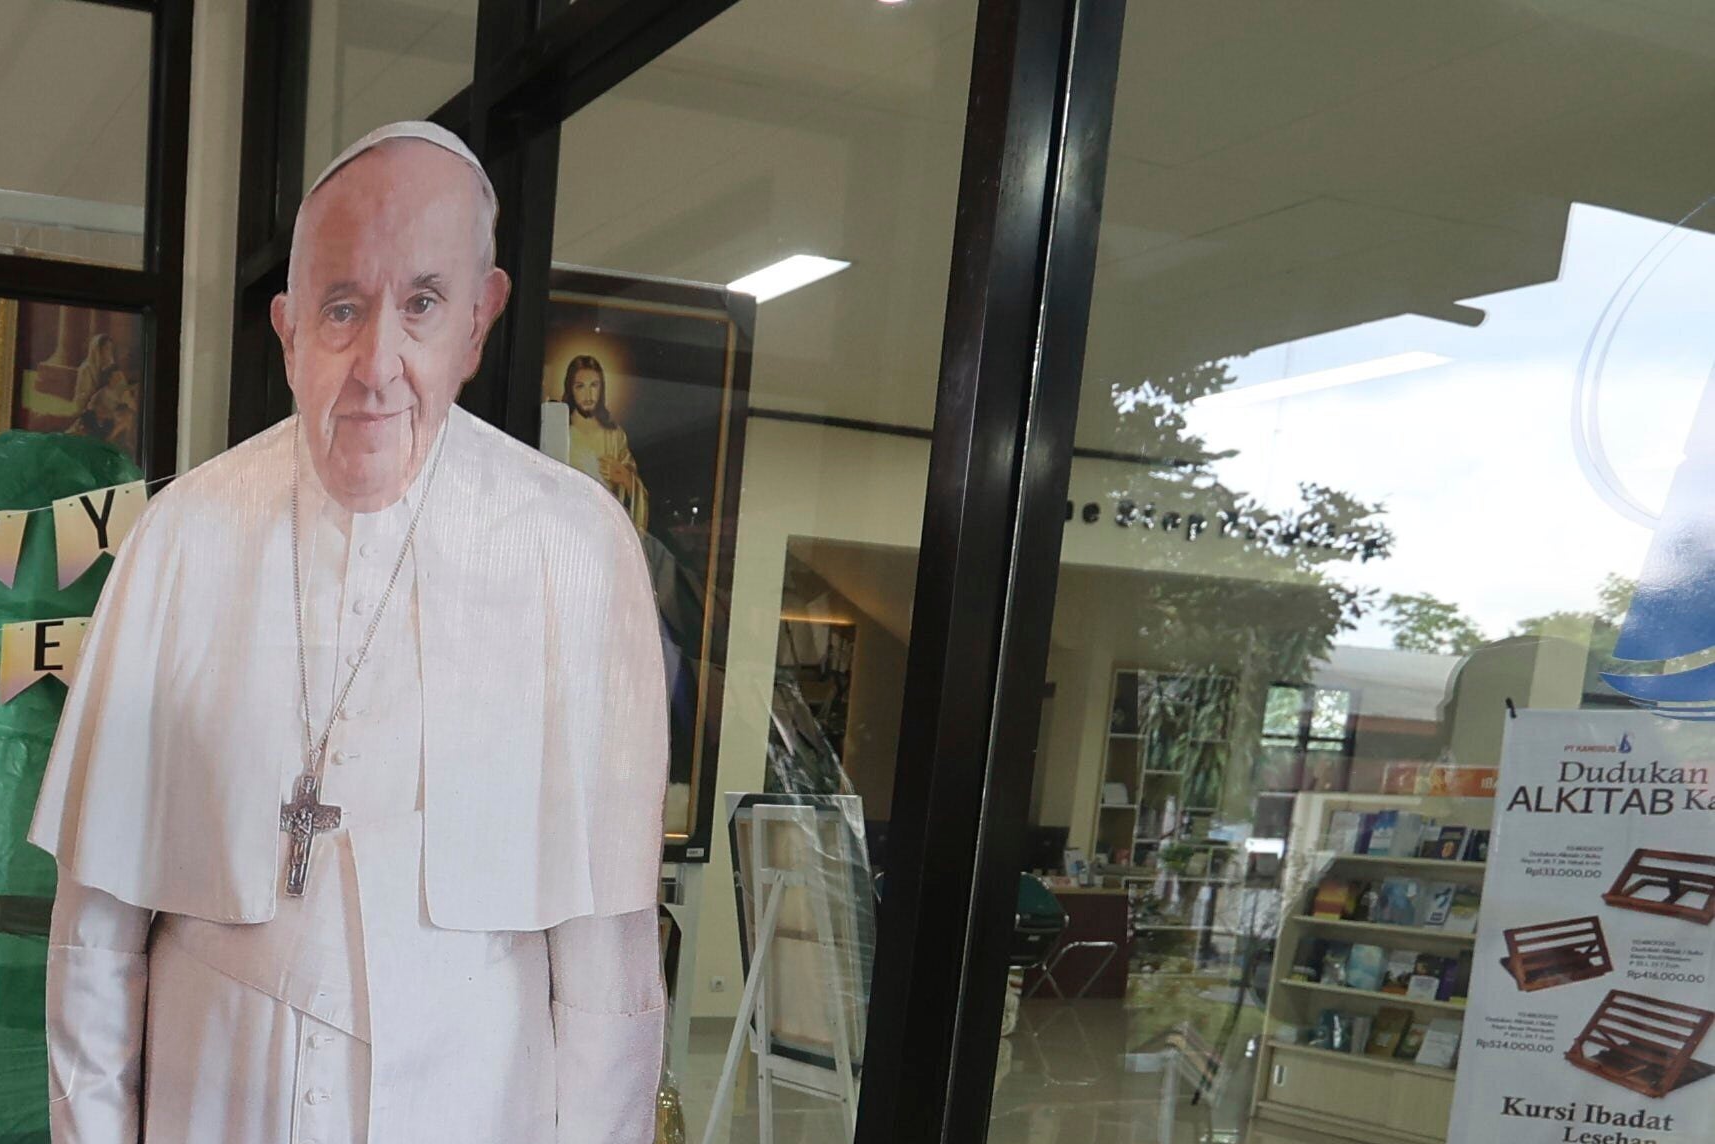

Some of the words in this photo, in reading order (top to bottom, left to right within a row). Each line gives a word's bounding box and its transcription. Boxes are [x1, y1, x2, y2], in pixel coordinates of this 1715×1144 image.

[1558, 760, 1708, 785] Dudukan
[1506, 786, 1674, 815] ALKITAB
[1500, 1096, 1576, 1122] Kursi
[1582, 1103, 1675, 1131] Ibadat
